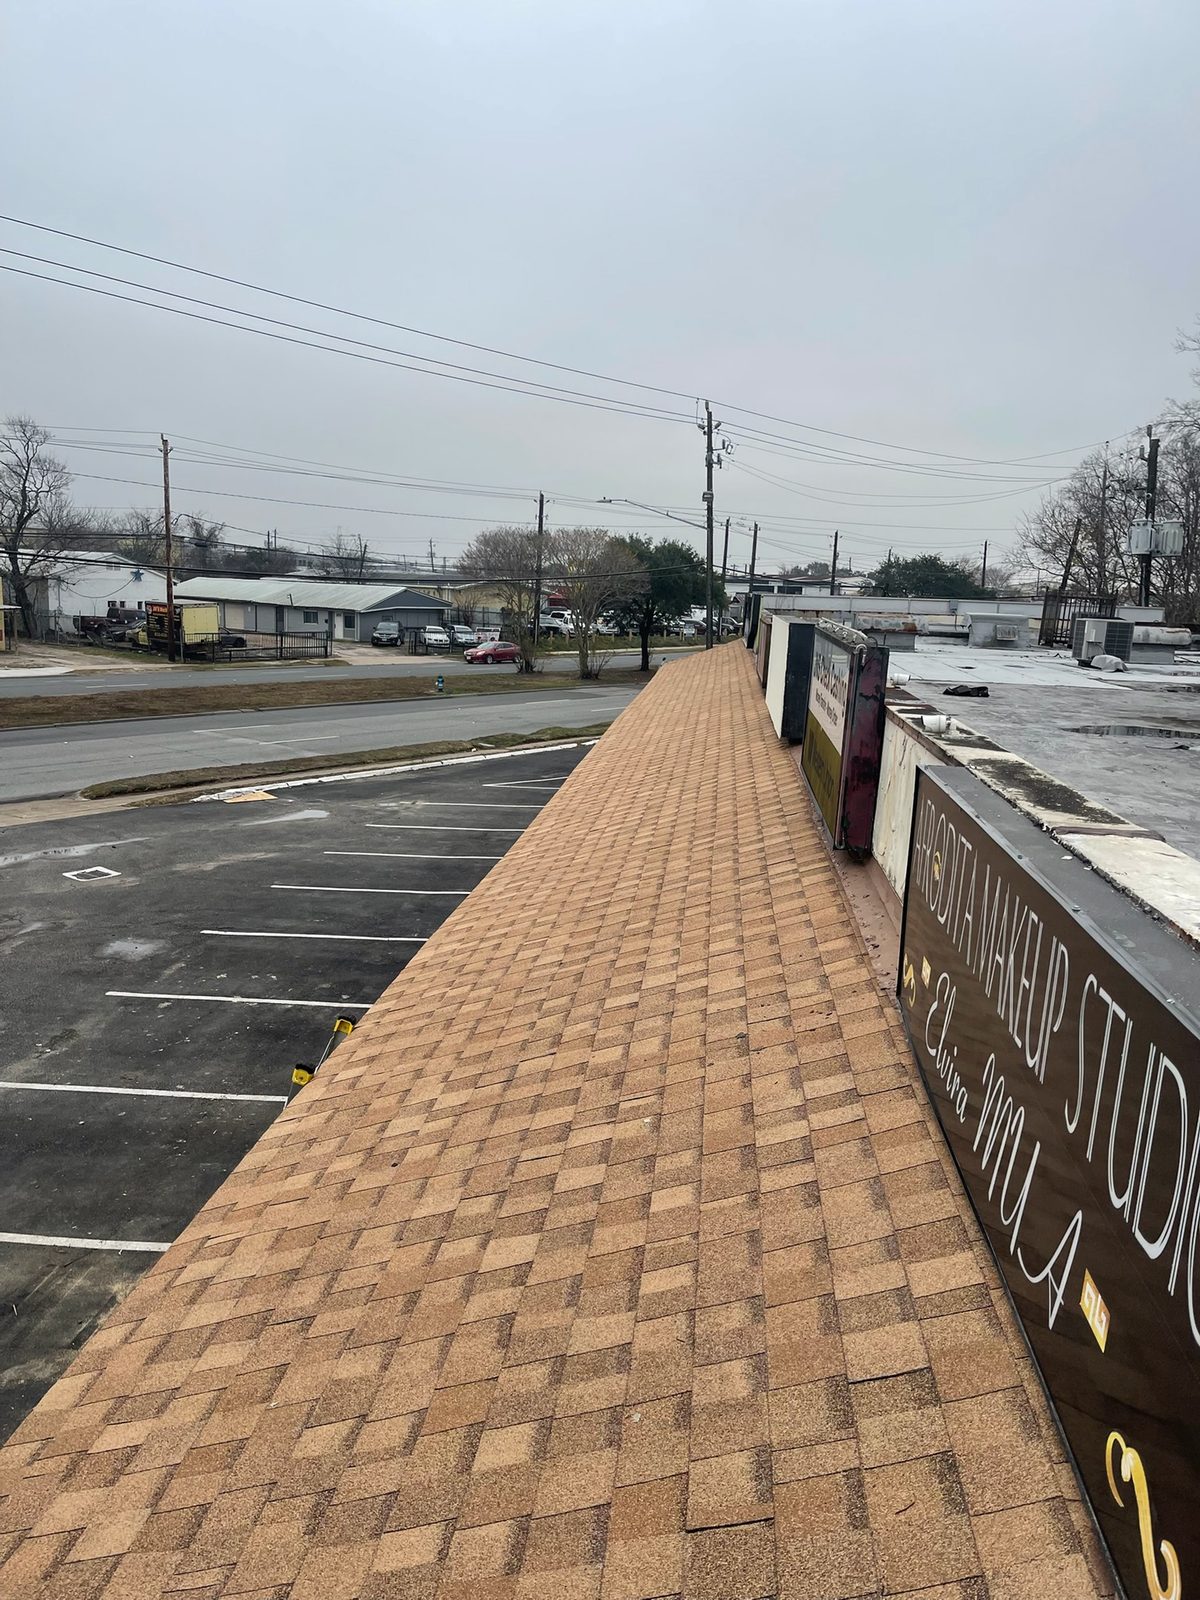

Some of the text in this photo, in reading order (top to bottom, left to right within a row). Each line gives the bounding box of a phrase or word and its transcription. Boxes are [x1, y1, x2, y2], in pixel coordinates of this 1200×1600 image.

[912, 792, 978, 966] AFRODITA
[973, 863, 1070, 1085] MAKEUP
[925, 972, 968, 1124] Elvira
